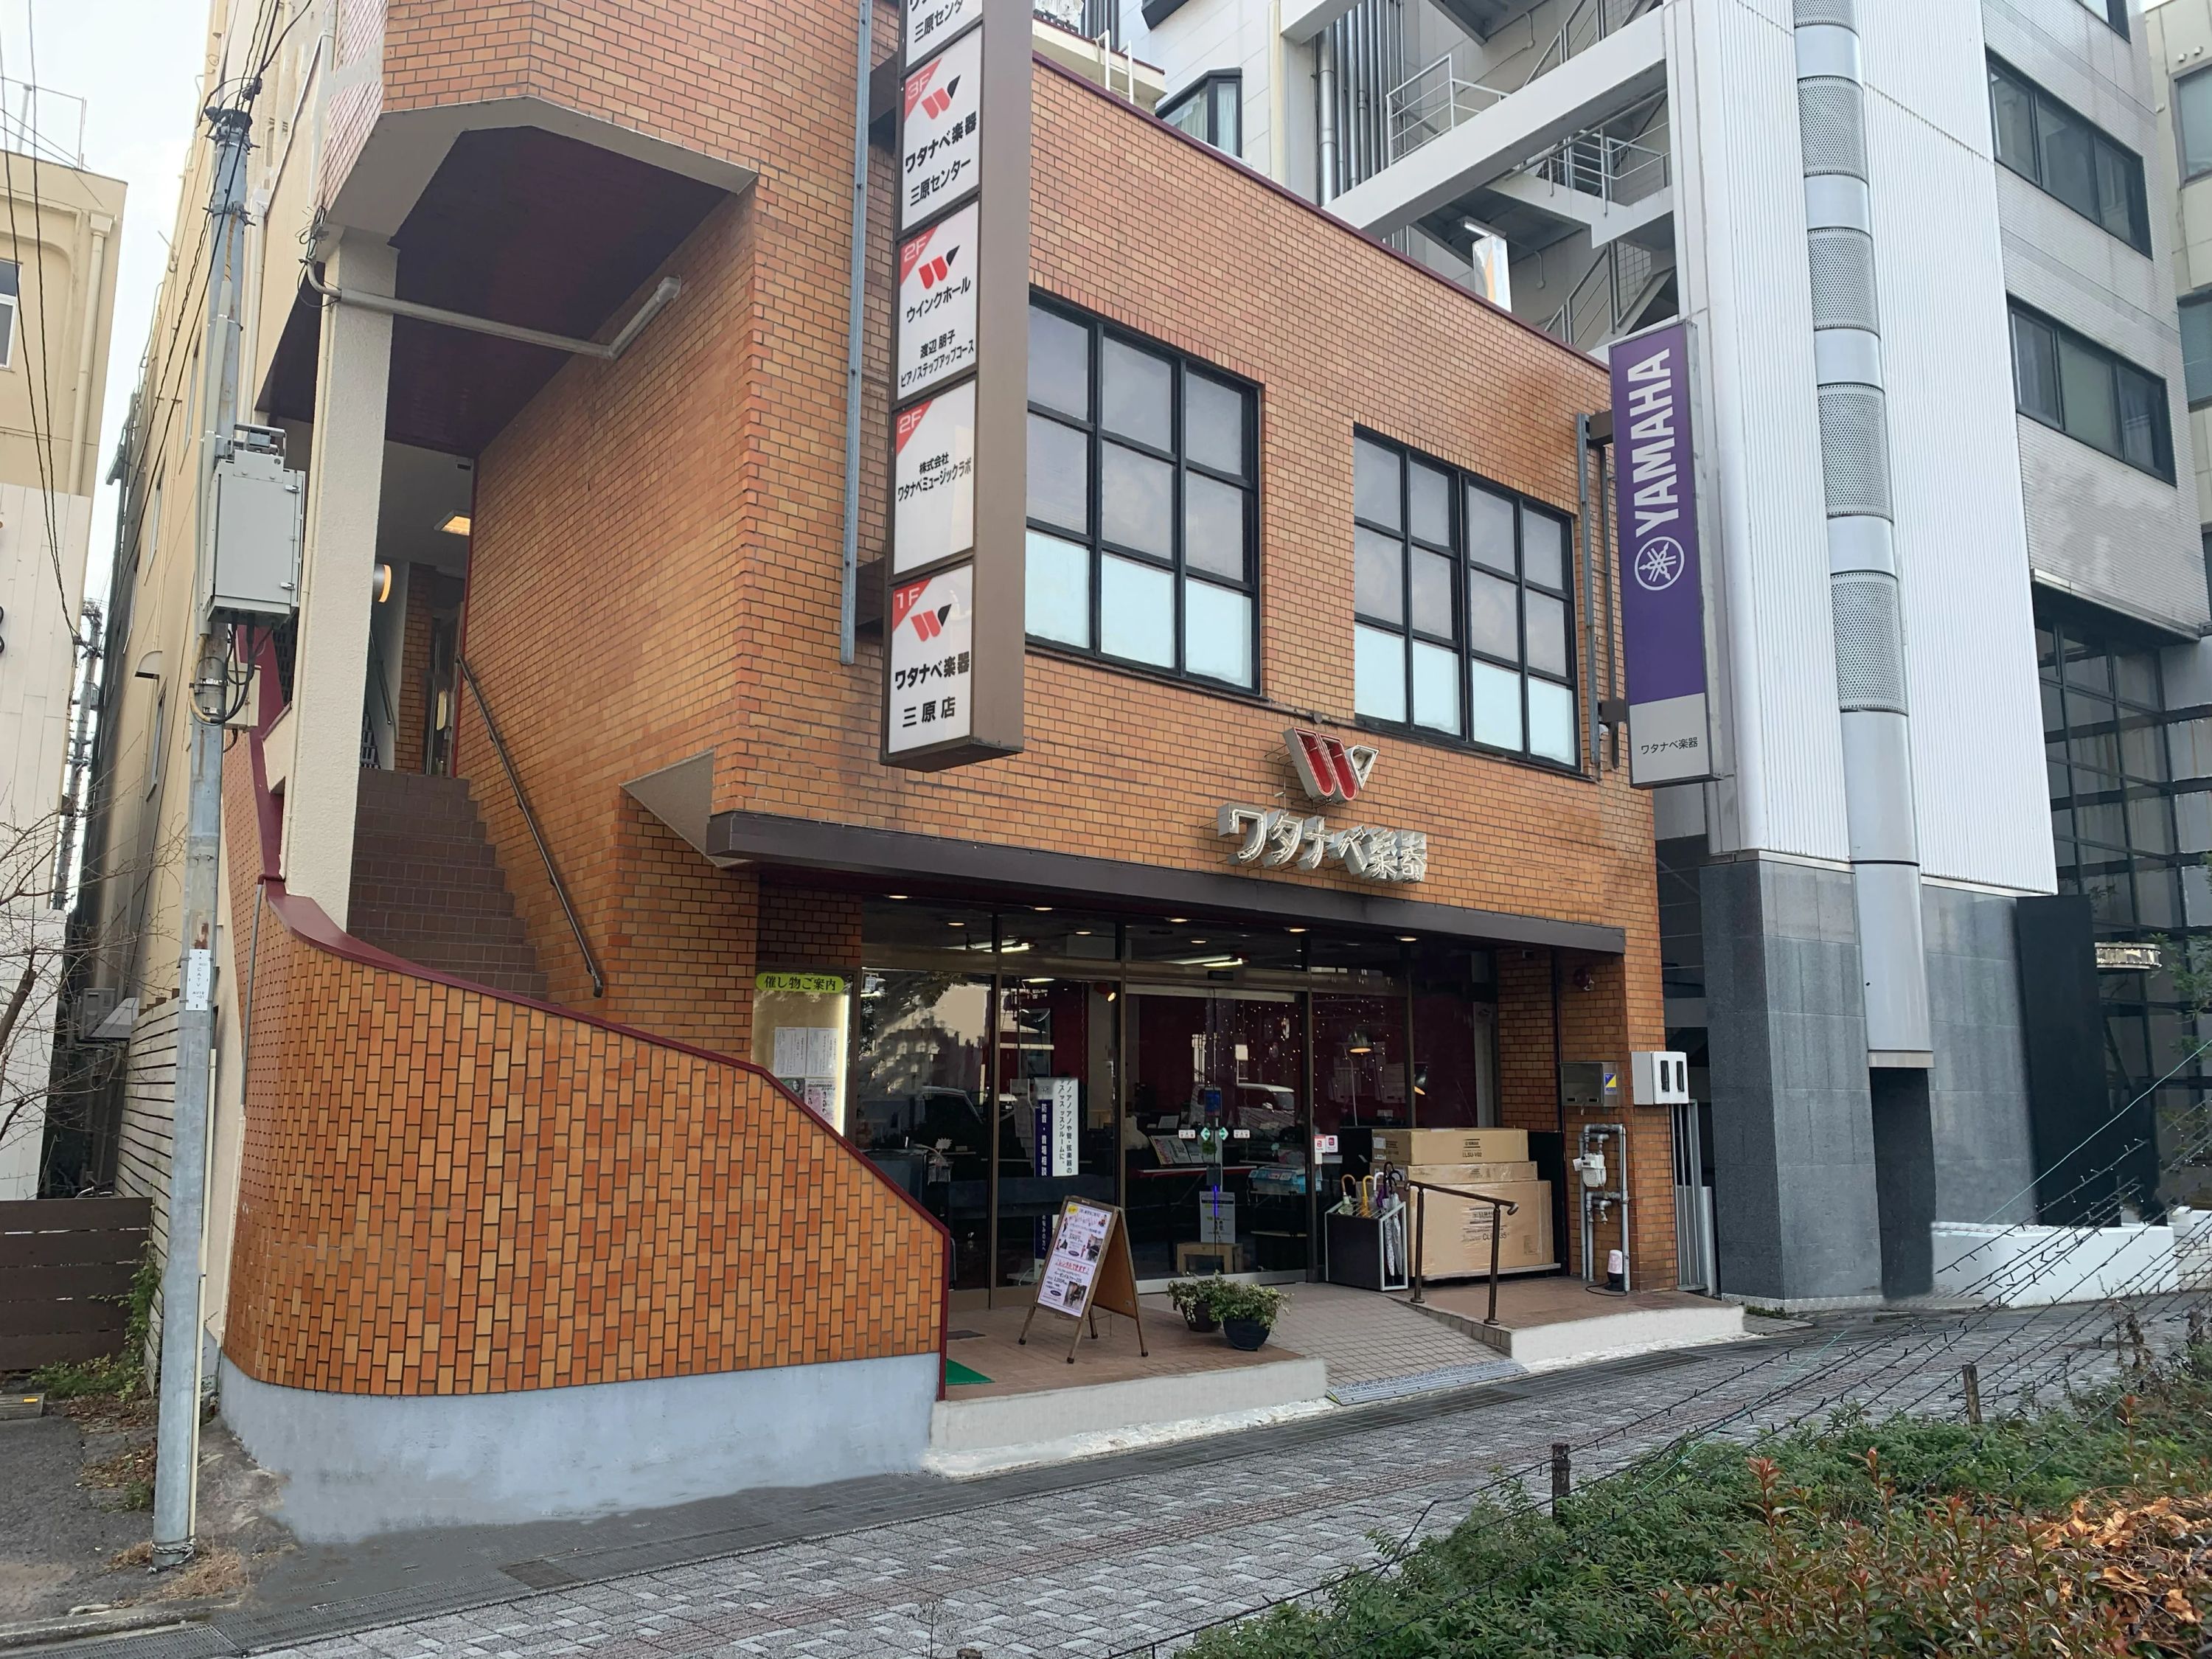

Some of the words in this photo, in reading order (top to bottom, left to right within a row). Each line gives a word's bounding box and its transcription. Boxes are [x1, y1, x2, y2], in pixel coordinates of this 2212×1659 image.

[908, 72, 930, 100] 3F
[905, 111, 977, 174] ワタナベ楽器
[910, 158, 971, 206] 三原センター
[904, 235, 928, 263] 2F
[899, 408, 922, 434] 2F
[1628, 348, 1679, 538] YAMAHA
[919, 451, 950, 475] 株式会社
[897, 456, 972, 502] ワタナベミュージックラボ
[897, 587, 920, 609] 1F
[894, 650, 970, 691] ワタナベ楽器
[902, 696, 956, 728] 三原店
[1641, 737, 1699, 755] ワタナベ楽器
[1217, 802, 1427, 884] ワタナベ楽器
[765, 975, 837, 992] 催し物ご案内
